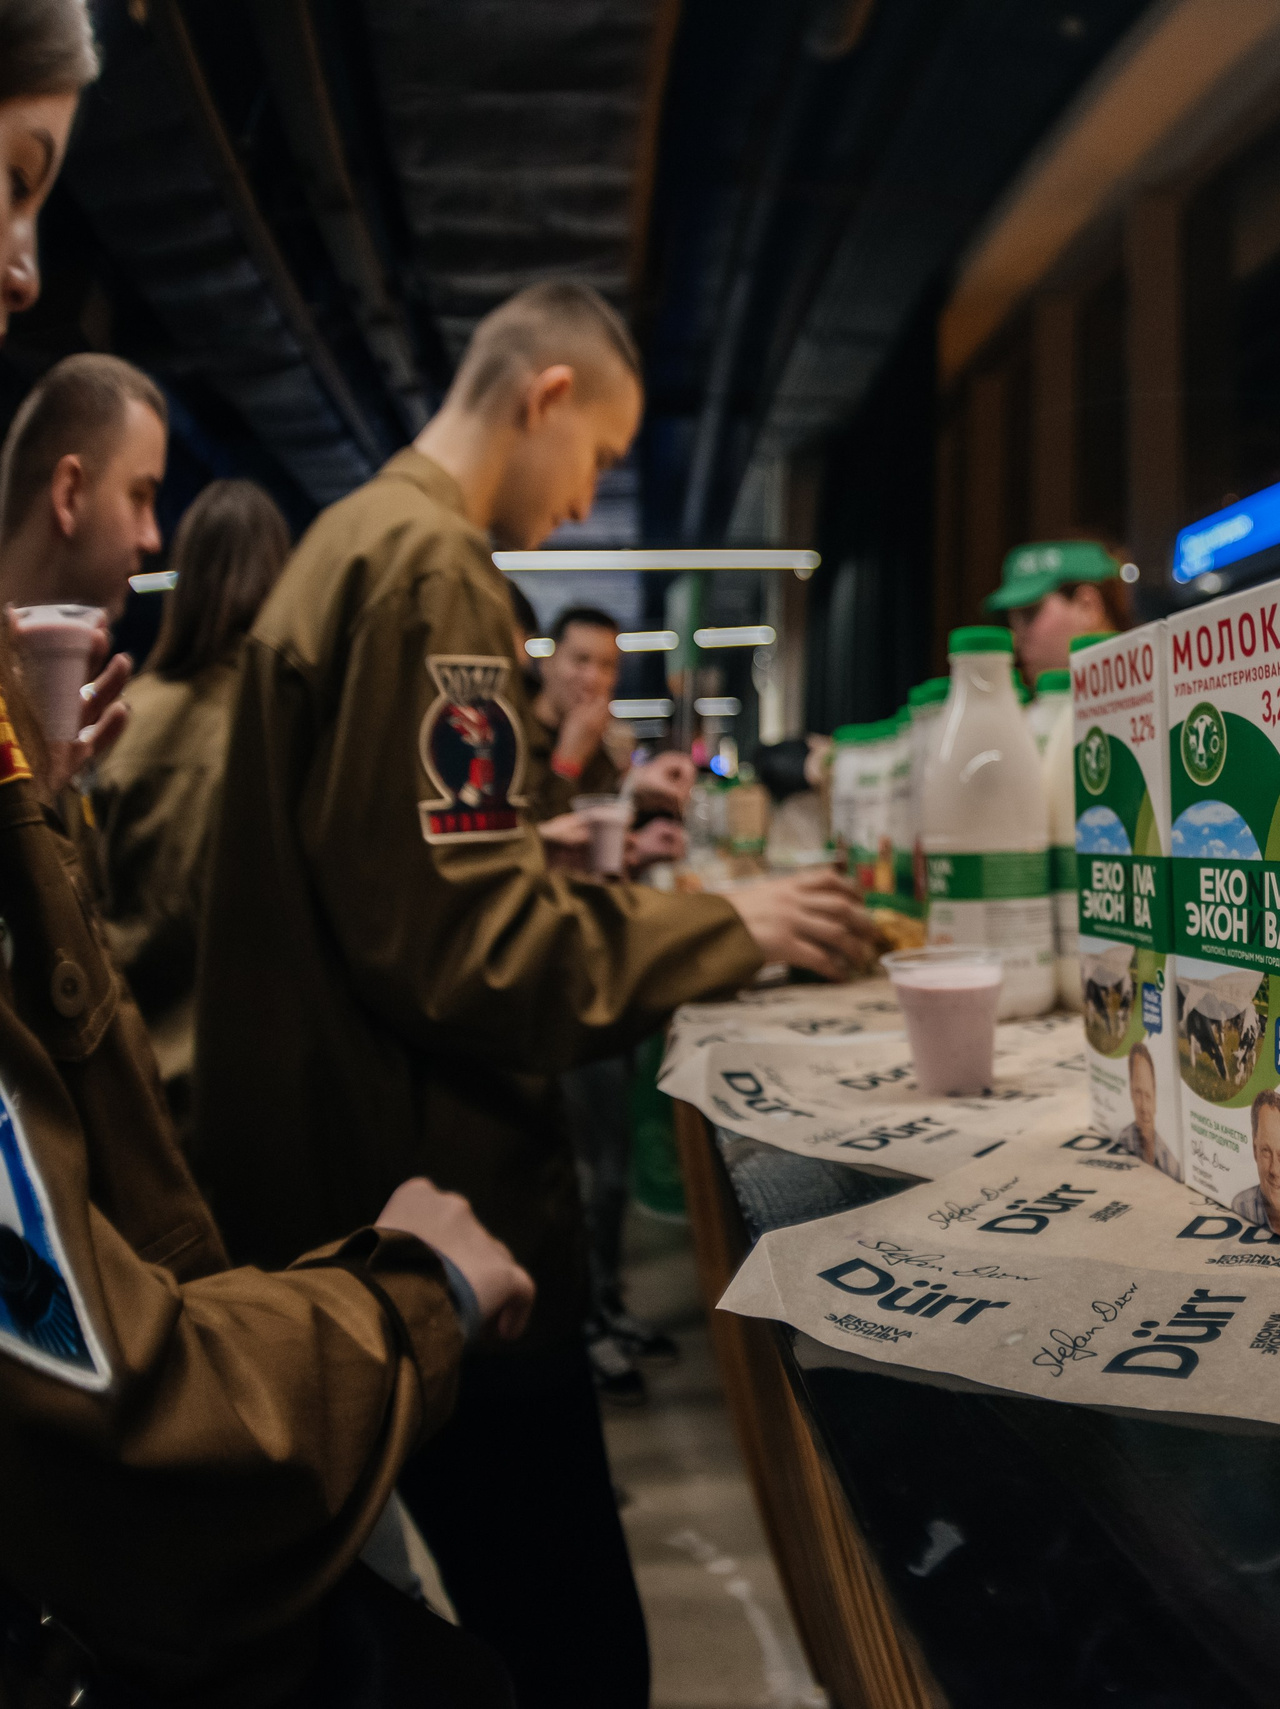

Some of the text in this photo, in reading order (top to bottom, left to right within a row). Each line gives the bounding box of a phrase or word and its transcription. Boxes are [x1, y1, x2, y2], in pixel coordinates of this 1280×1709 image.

[1074, 643, 1153, 701] МОЛОКО
[1092, 861, 1155, 897] EKOIVA
[1082, 889, 1152, 930] ЭКОНВА
[1201, 944, 1227, 958] МОЛОКО,
[1227, 948, 1255, 962] КОТОРЫМ
[1255, 953, 1265, 964] МЫ
[977, 1183, 1098, 1235] Dürr
[816, 1257, 1011, 1324] Dürr
[824, 1312, 899, 1343] ЭКОНИВА
[845, 1313, 914, 1339] EKONIVA
[1101, 1288, 1247, 1379] Dürr
